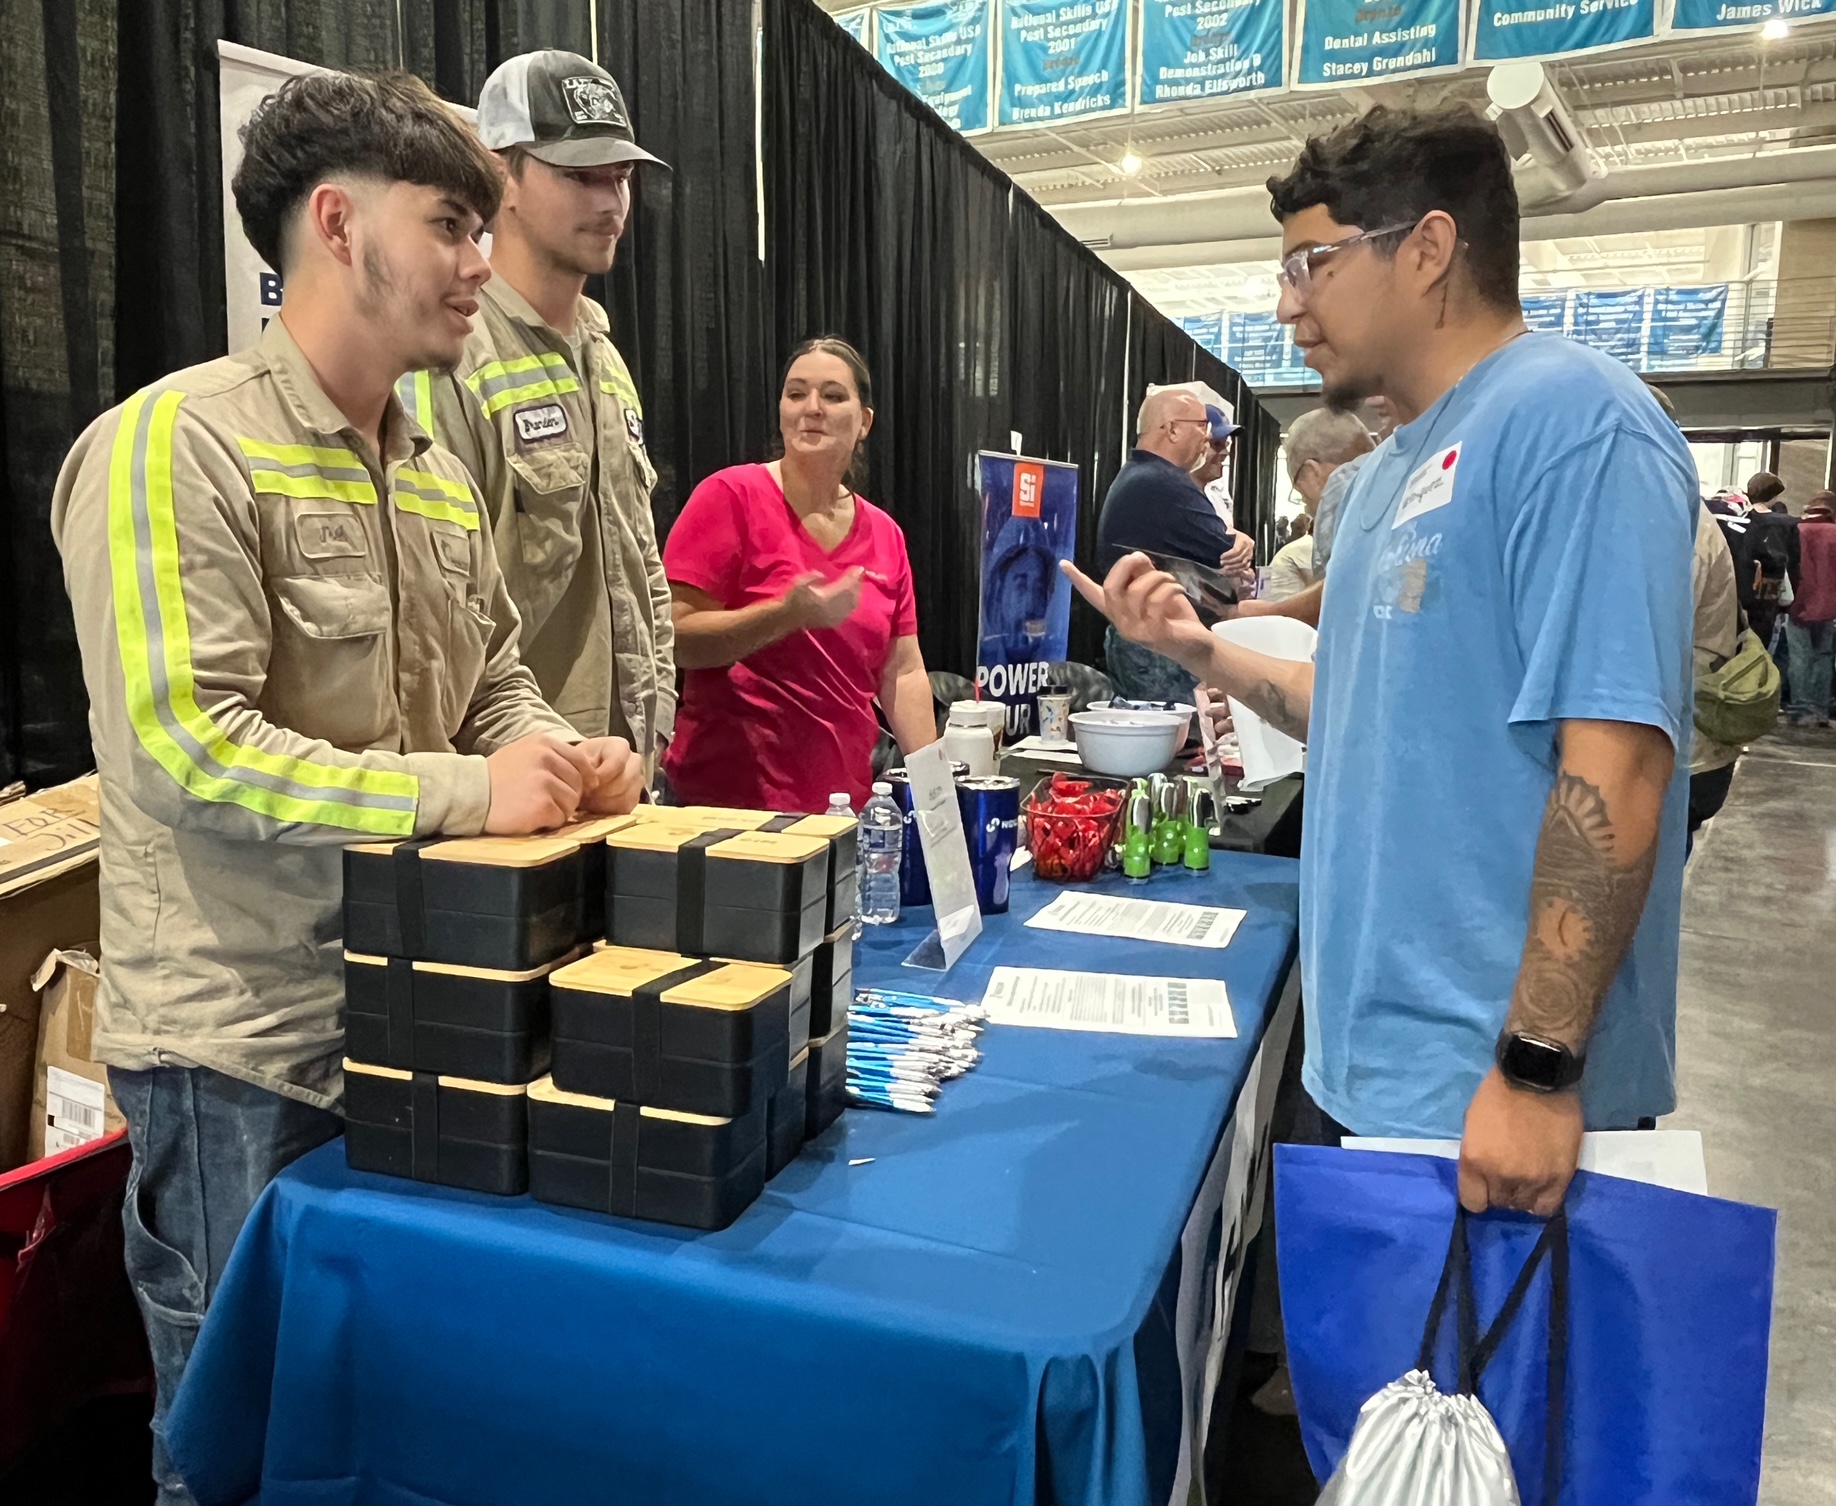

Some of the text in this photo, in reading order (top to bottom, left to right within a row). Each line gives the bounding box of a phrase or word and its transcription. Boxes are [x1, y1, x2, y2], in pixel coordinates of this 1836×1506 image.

[1011, 10, 1056, 29] National
[1059, 5, 1092, 22] Skills
[1165, 3, 1191, 17] Post
[1493, 5, 1576, 27] Community
[1716, 3, 1772, 21] James
[1020, 18, 1108, 42] Post Secondary
[1196, 13, 1228, 30] 2002
[1048, 37, 1076, 54] 2001
[1324, 24, 1436, 50] Dental Assisting
[1184, 44, 1238, 64] Job Skill
[1159, 58, 1250, 79] Demonstration
[1322, 61, 1369, 77] Stacey
[1014, 69, 1109, 98] Prepared Speech
[1155, 71, 1265, 98] Rhonda Ellsworth
[1012, 94, 1111, 120] Brenda Kendricks
[976, 661, 1050, 697] POWER
